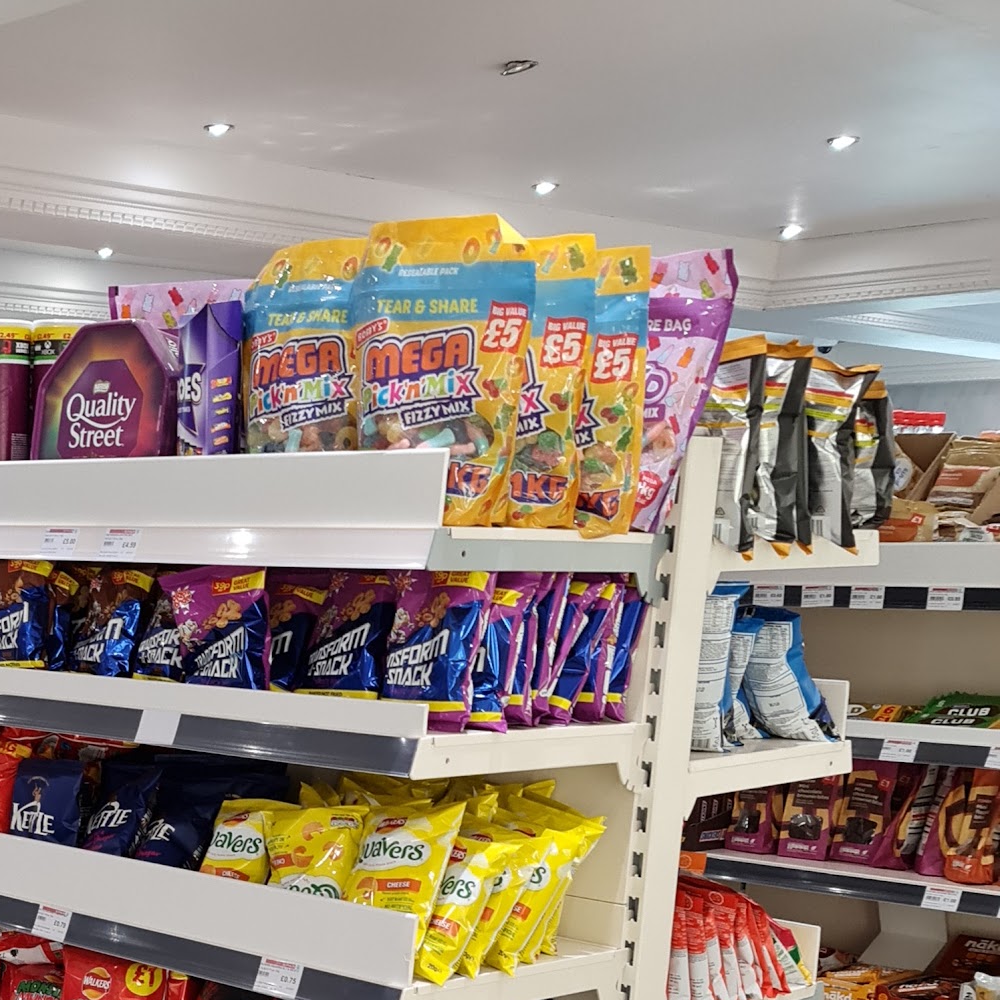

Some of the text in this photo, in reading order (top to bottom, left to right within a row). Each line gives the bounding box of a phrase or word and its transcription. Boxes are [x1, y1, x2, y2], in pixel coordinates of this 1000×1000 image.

[376, 298, 479, 314] TEAR & SHARE
[505, 306, 527, 317] VALUE
[306, 310, 348, 324] SHARE
[562, 321, 586, 332] VALUE
[663, 318, 692, 332] BAG
[483, 318, 522, 348] £5
[543, 332, 582, 364] £5
[612, 337, 637, 347] VALUE
[366, 332, 469, 381] MEGA
[253, 340, 342, 388] MEGA
[594, 350, 632, 379] £5
[66, 392, 137, 423] Quality
[68, 423, 124, 449] Street
[232, 576, 250, 586] GREAT
[232, 582, 250, 592] VALUE
[947, 707, 991, 717] CLUB
[10, 801, 54, 836] KETTLE
[386, 880, 411, 889] CHEESE
[83, 976, 112, 990] WALKERS
[280, 975, 297, 985] £0.75
